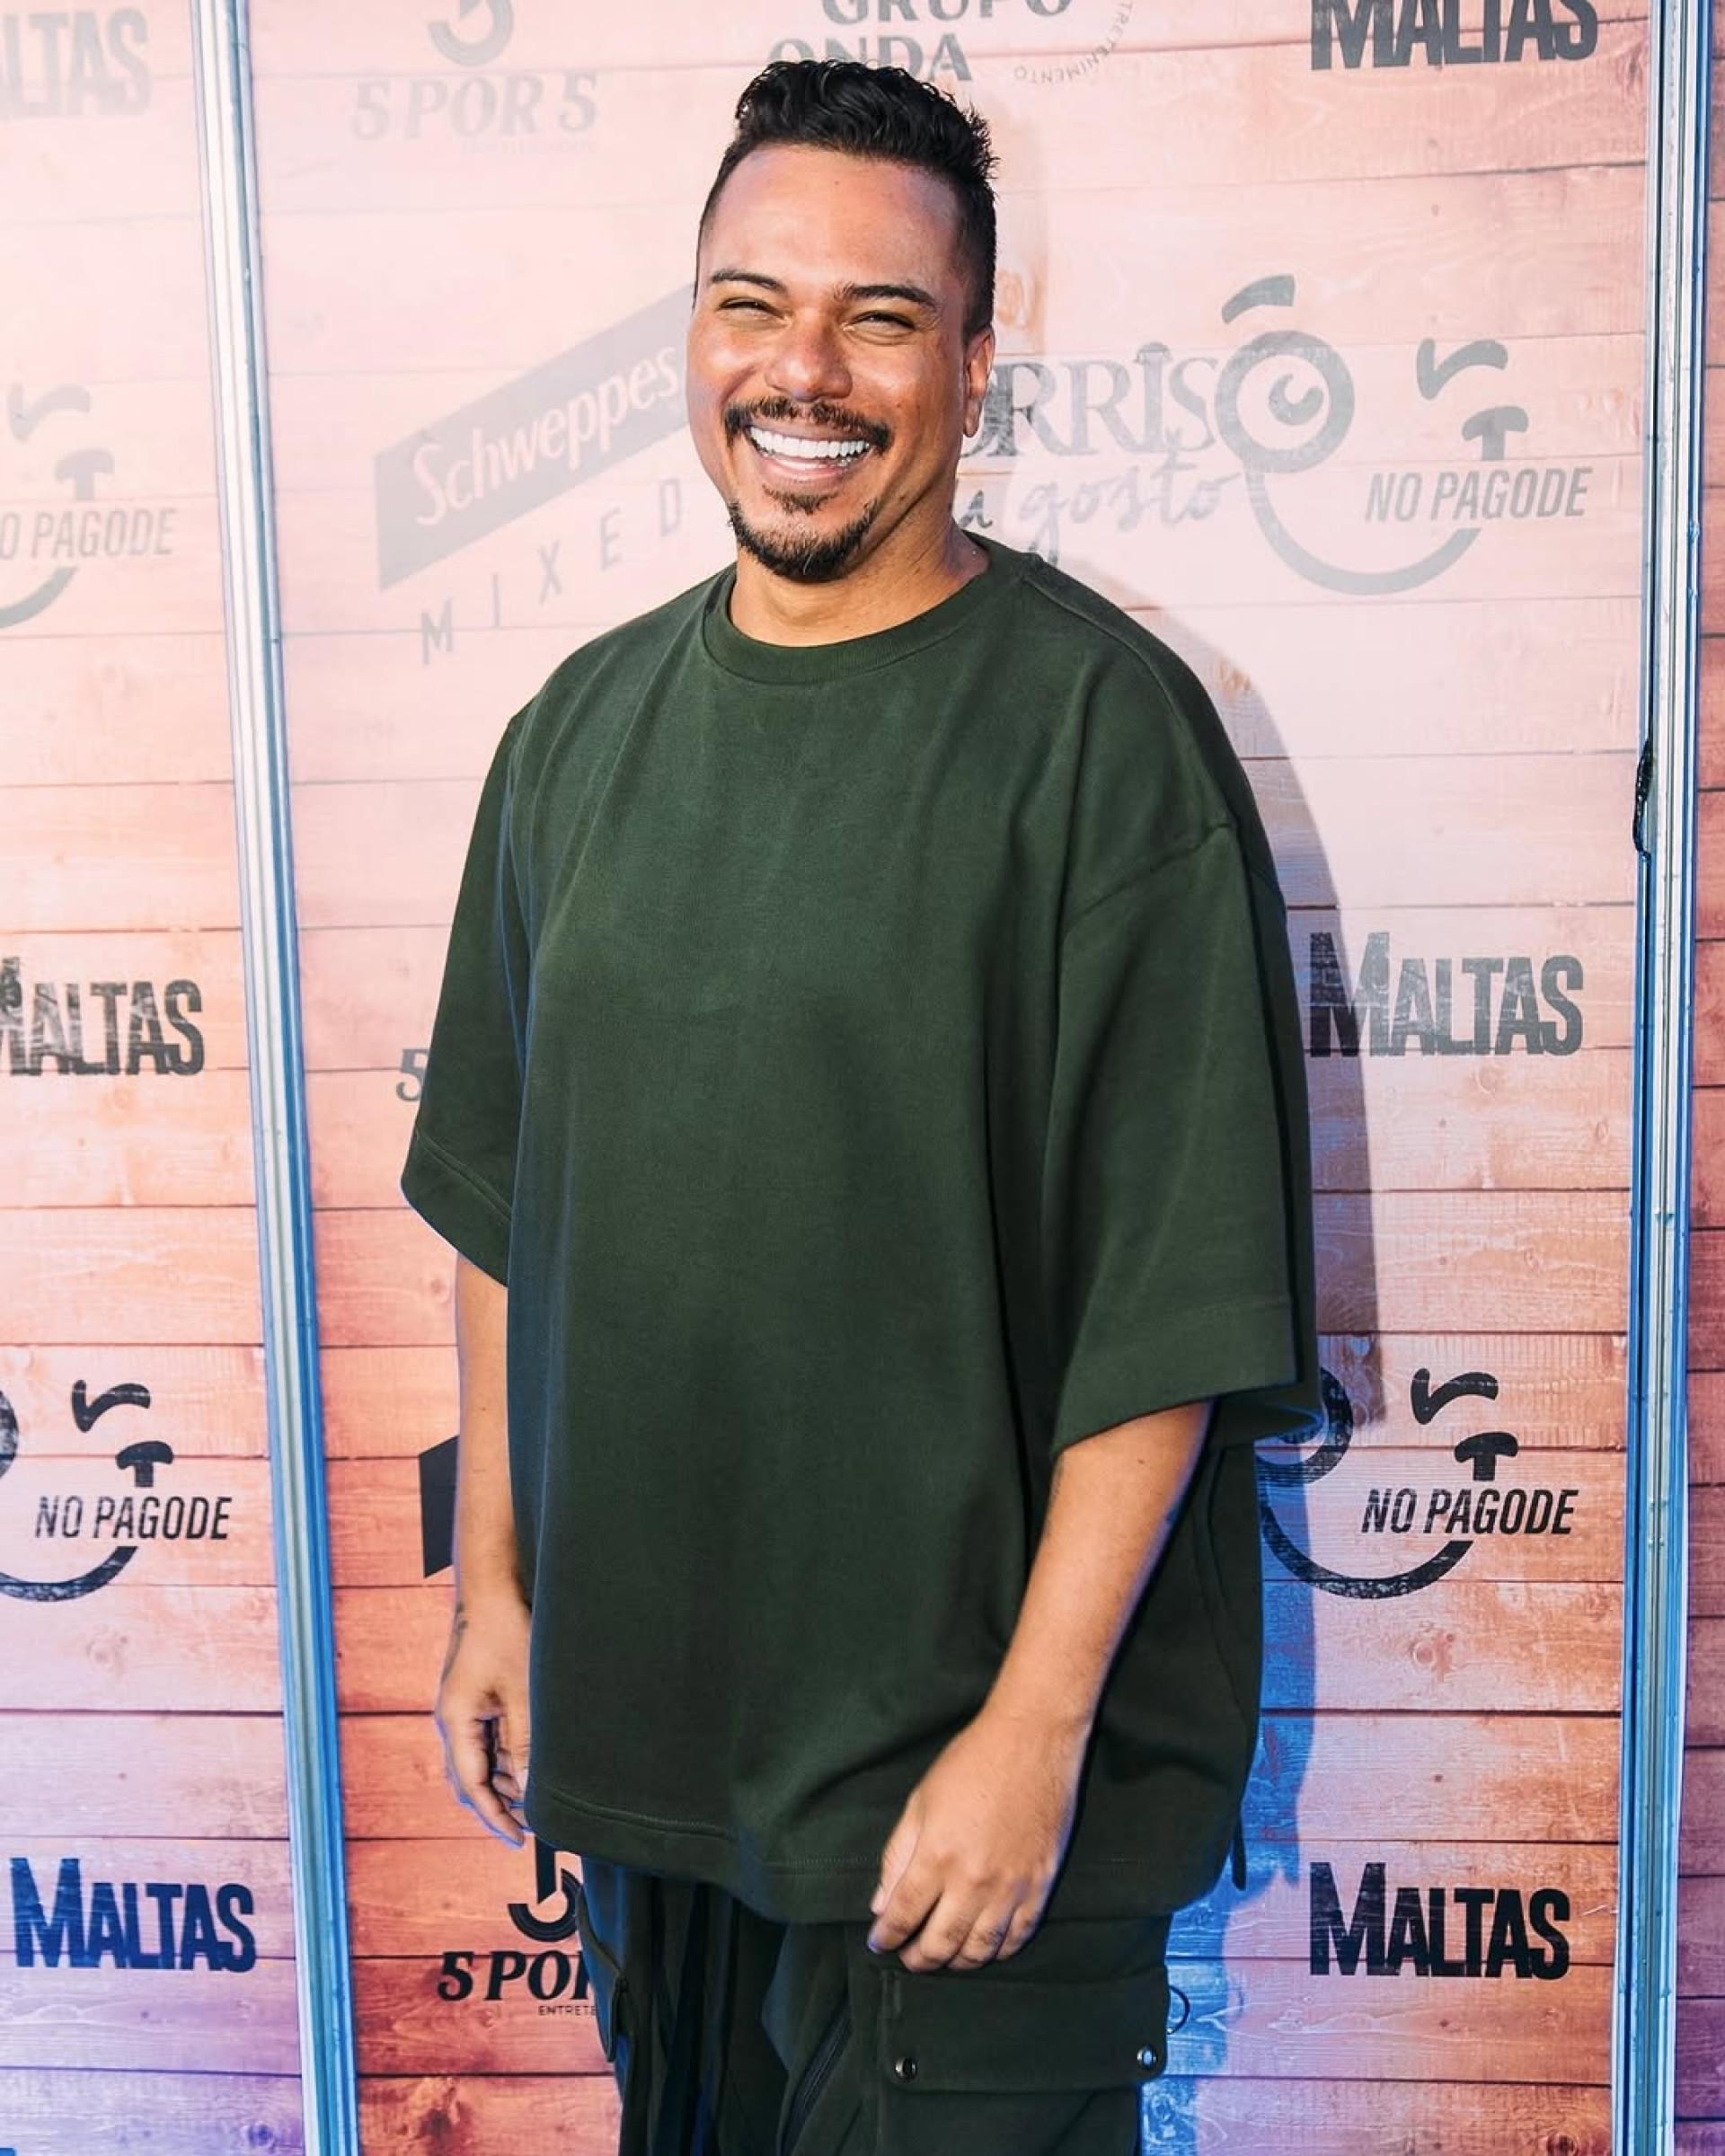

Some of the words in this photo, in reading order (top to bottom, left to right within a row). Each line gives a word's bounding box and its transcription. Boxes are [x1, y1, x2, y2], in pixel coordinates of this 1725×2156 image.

[0, 7, 151, 117] LTAS
[1311, 0, 1598, 70] MALTAS
[404, 74, 544, 140] POR
[412, 345, 679, 526] Schweppes
[1364, 472, 1423, 523] NO
[1430, 466, 1593, 521] PAGODE
[0, 511, 22, 560] O
[31, 508, 179, 559] PAGODE
[420, 476, 681, 665] MIXED
[1310, 932, 1584, 1057] MALTAS
[34, 1496, 83, 1539] NO
[93, 1496, 233, 1540] PAGODE
[1361, 1488, 1418, 1533] NO
[1423, 1489, 1579, 1534] PAGODE
[10, 1857, 256, 1973] MALTAS
[1310, 1862, 1570, 1980] MALTAS
[538, 2005, 597, 2017] ENTRETE
